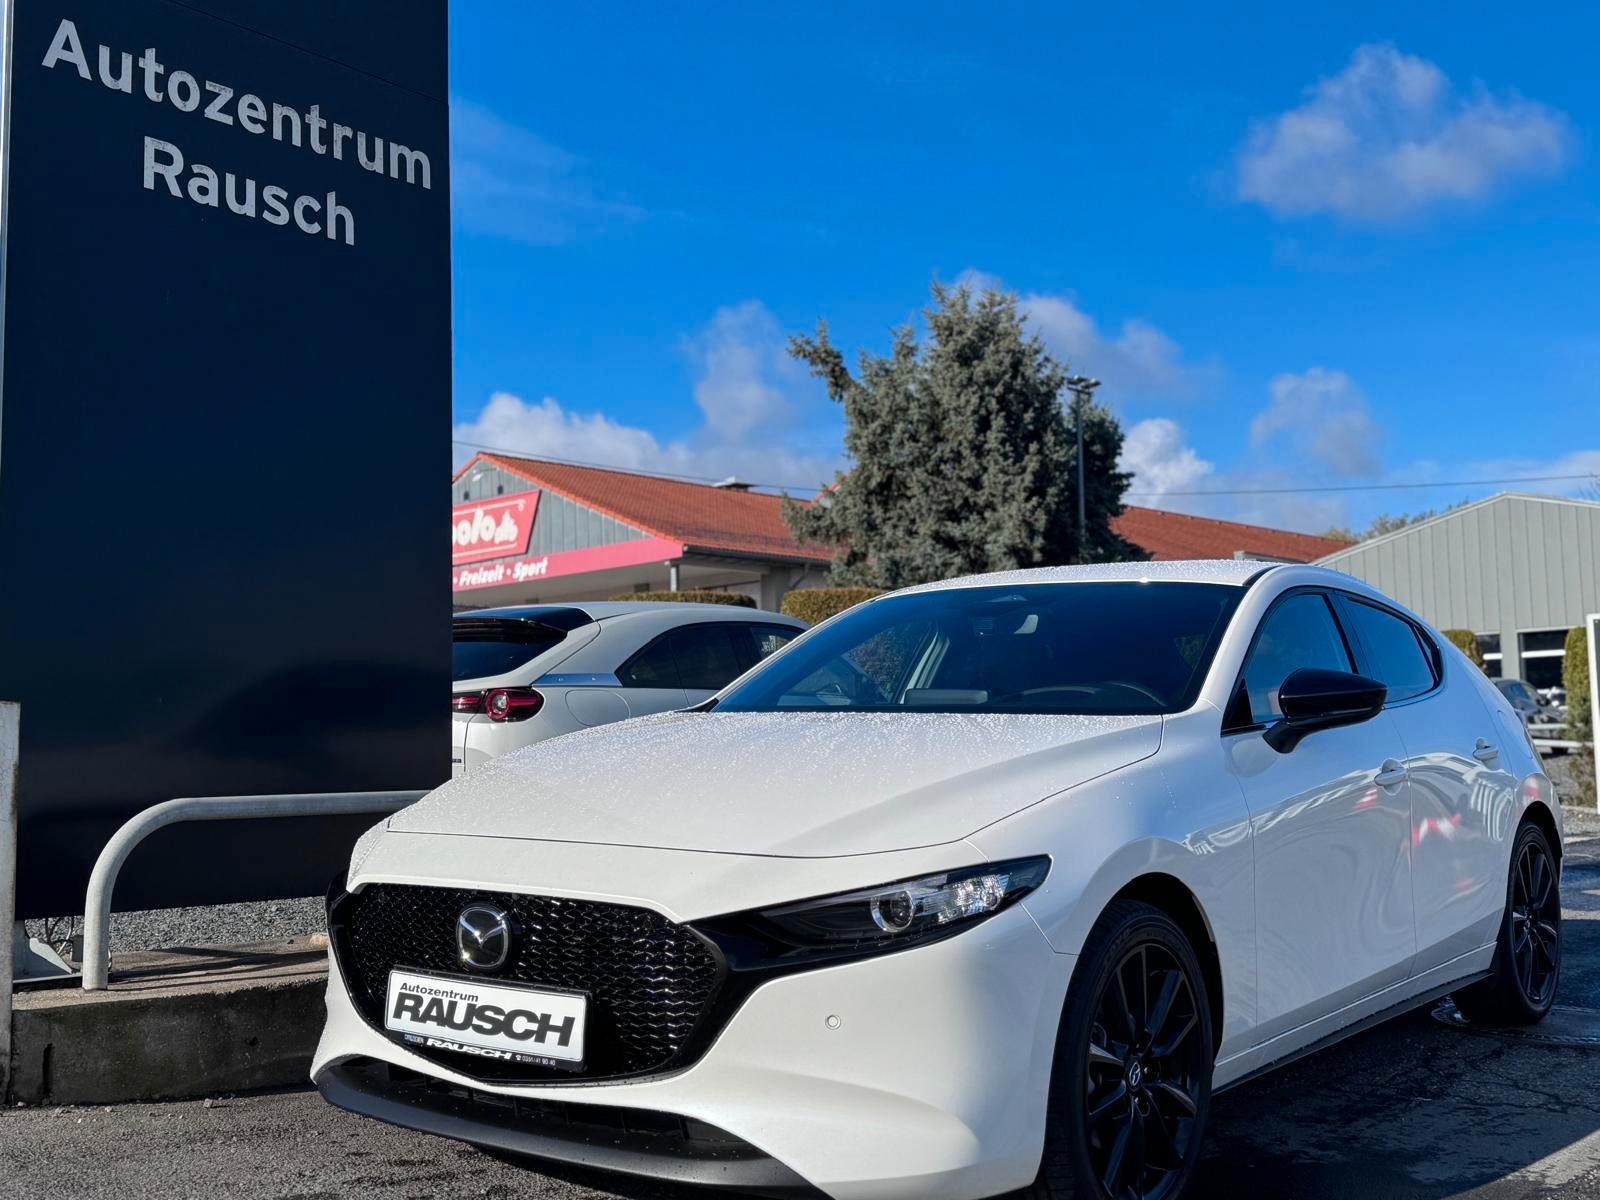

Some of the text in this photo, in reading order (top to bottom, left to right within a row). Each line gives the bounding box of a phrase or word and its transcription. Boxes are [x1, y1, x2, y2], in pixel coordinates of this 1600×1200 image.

[41, 18, 432, 190] Autozentrum
[143, 135, 356, 246] Rausch
[459, 557, 548, 586] Freizeit Sport
[399, 982, 479, 1003] Autozentrum
[392, 991, 576, 1047] RAUSCH
[426, 1038, 513, 1060] RAUSCH
